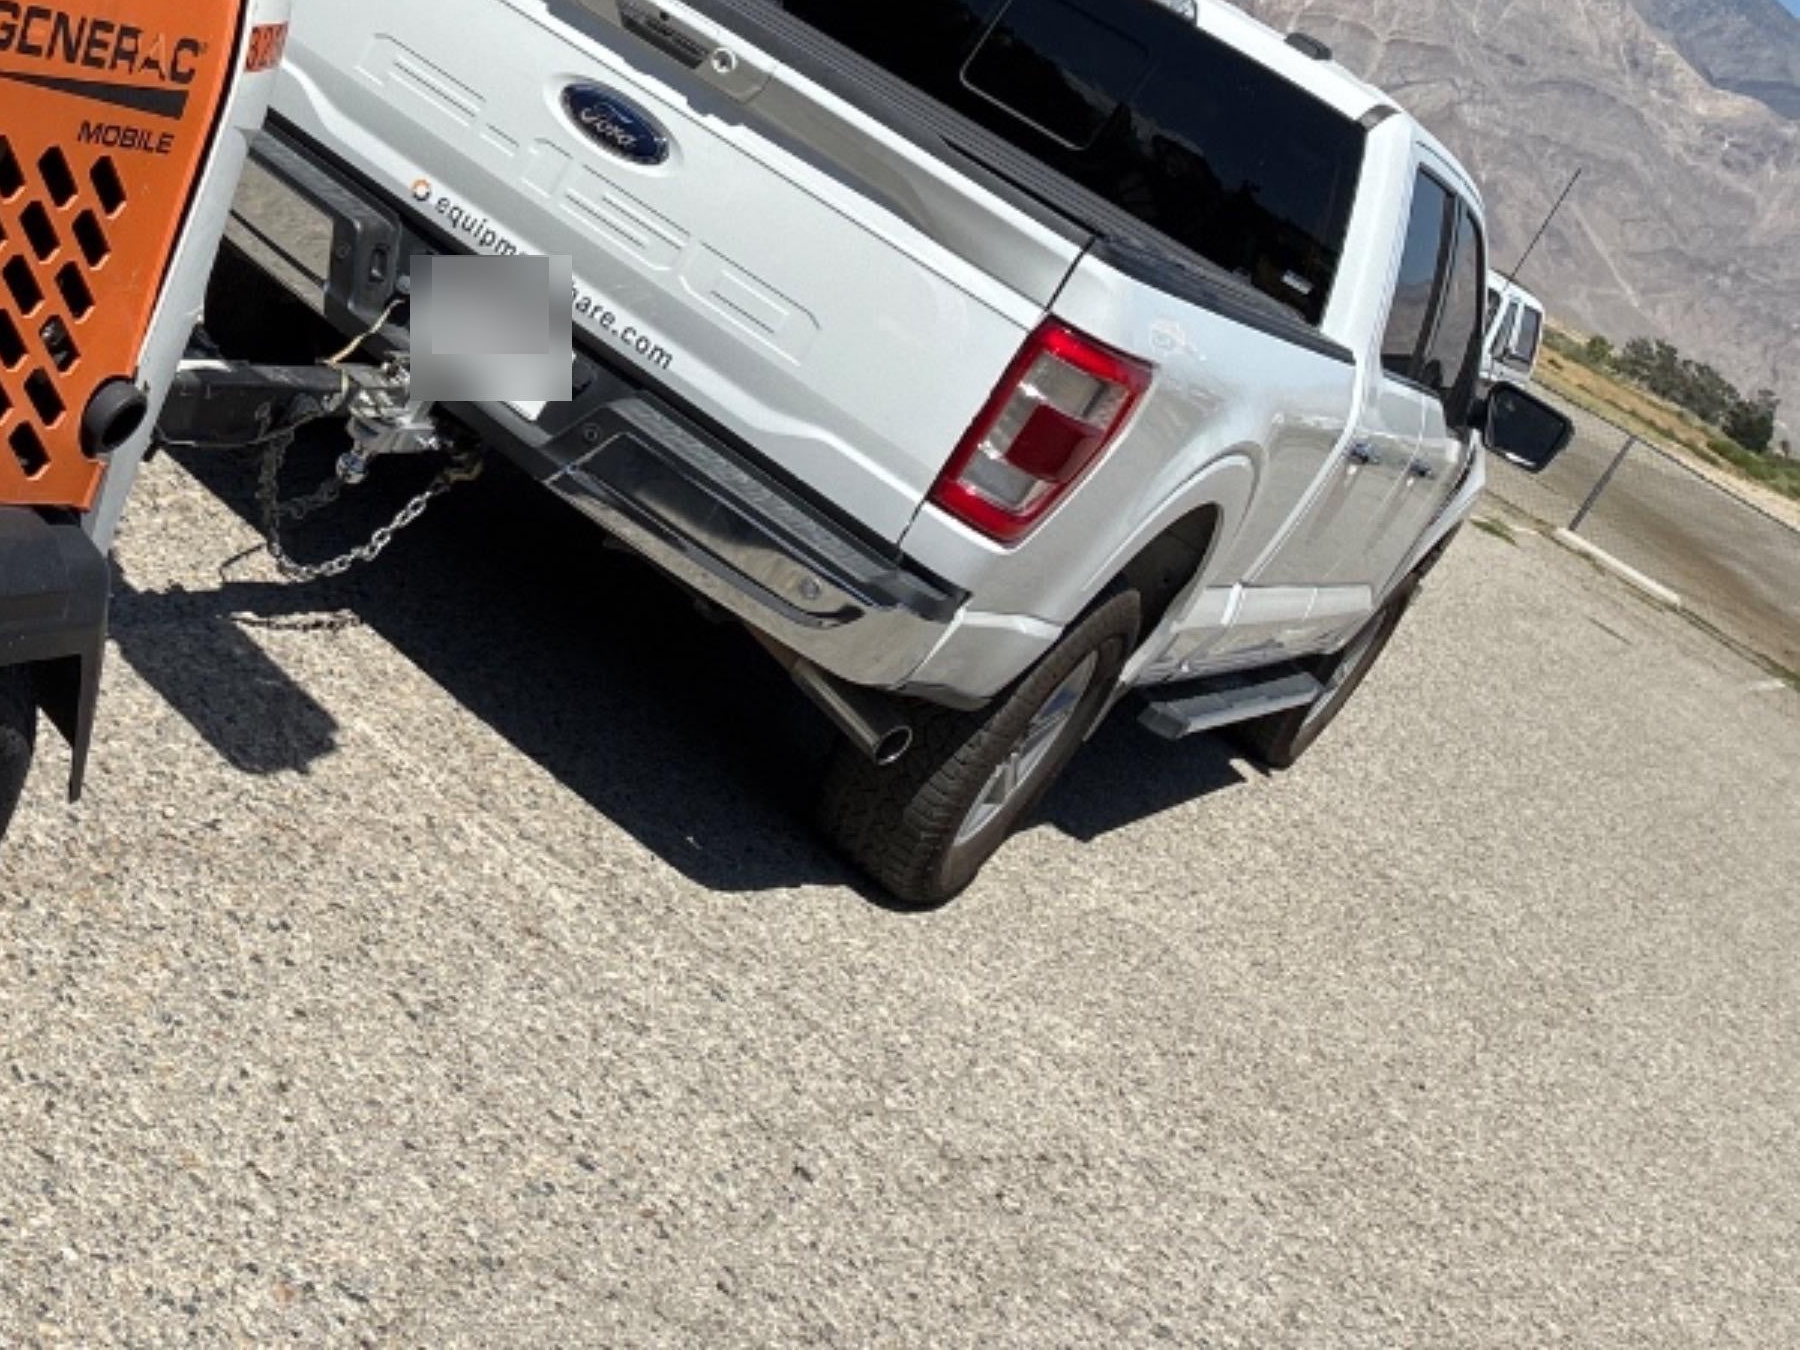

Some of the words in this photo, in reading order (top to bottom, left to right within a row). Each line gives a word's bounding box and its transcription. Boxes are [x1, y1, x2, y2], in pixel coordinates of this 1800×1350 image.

[78, 120, 174, 154] MOBILE
[580, 102, 638, 147] Ford
[434, 196, 673, 370] equipmare.com
